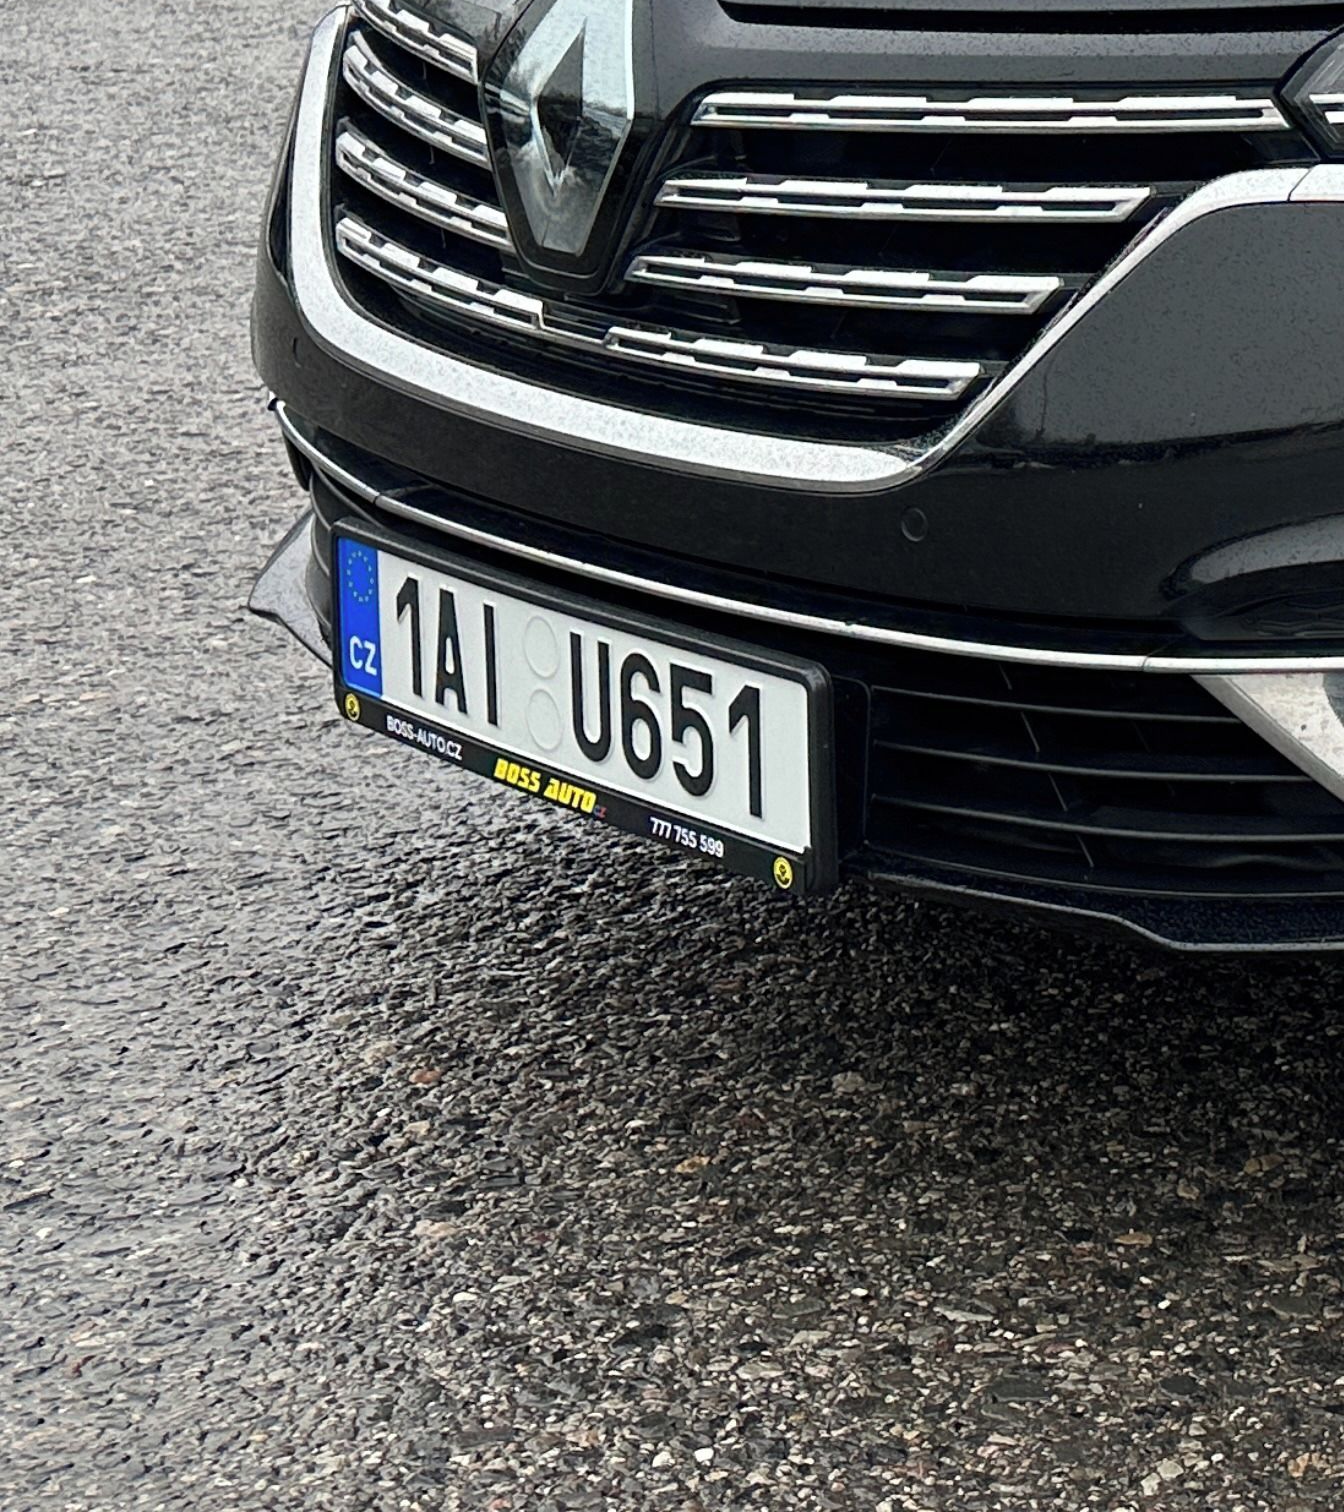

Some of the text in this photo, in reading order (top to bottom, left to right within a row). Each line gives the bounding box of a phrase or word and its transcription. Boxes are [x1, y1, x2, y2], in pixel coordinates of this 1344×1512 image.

[349, 635, 378, 677] CZ
[396, 576, 763, 819] 1AI U651
[494, 757, 541, 793] BOSS
[543, 777, 597, 814] AUTO
[650, 816, 725, 859] 777 755 599
